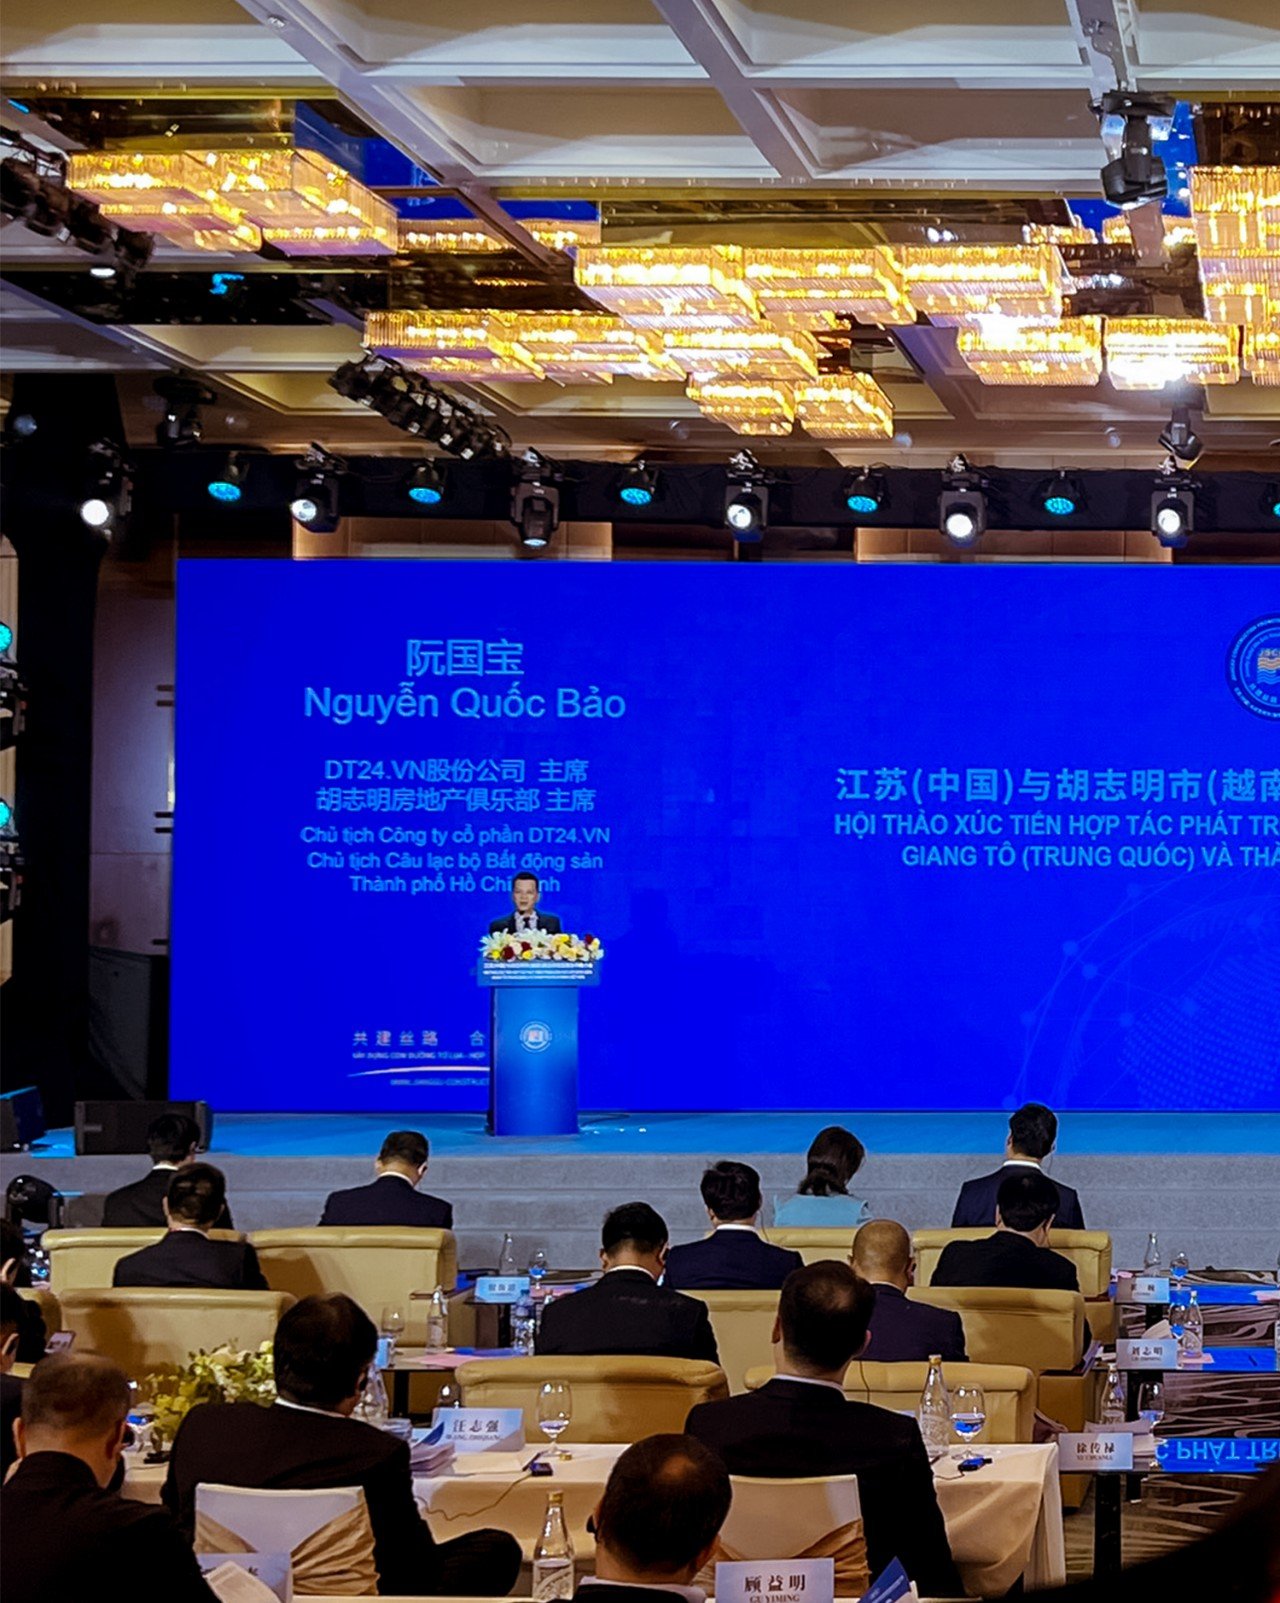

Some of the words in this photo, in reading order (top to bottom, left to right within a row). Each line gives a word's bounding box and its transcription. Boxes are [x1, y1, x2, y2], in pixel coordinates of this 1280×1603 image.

[406, 638, 525, 677] 阮国宝
[304, 681, 439, 726] Nguyễn
[450, 681, 546, 720] Quốc
[556, 685, 626, 719] Bảo
[324, 758, 526, 783] DT24.VN股份公司
[538, 758, 589, 783] 主席
[316, 788, 541, 812] 胡志明房地产俱乐部
[545, 788, 596, 812] 主席
[300, 825, 338, 844] Chủ
[342, 827, 375, 846] tịch
[378, 826, 427, 847] Công
[431, 827, 449, 847] ty
[452, 823, 475, 844] cổ
[478, 823, 524, 848] phần
[528, 826, 611, 844] DT24.VN
[834, 810, 876, 839] HỘI
[953, 809, 1003, 836] XÚC
[1010, 810, 1062, 836] TIẾN
[1069, 814, 1121, 841] HỢP
[1125, 809, 1173, 836] TÁC
[1179, 809, 1243, 836] PHÁT
[307, 851, 345, 868] Chủ
[348, 852, 381, 871] tịch
[384, 851, 423, 868] Câu
[427, 852, 455, 871] lạc
[458, 852, 482, 871] bộ
[485, 849, 517, 869] Bất
[520, 852, 566, 872] động
[570, 851, 604, 869] sản
[901, 845, 977, 867] GIANG
[983, 840, 1017, 867] TÔ
[1022, 845, 1112, 871] (TRUNG
[1118, 841, 1195, 873] QUỐC)
[1200, 840, 1234, 867] VÀ
[349, 875, 407, 892] Thành
[410, 872, 446, 896] phố
[450, 872, 477, 893] Hồ
[538, 876, 561, 892] nh
[745, 1574, 806, 1593] 顾益明
